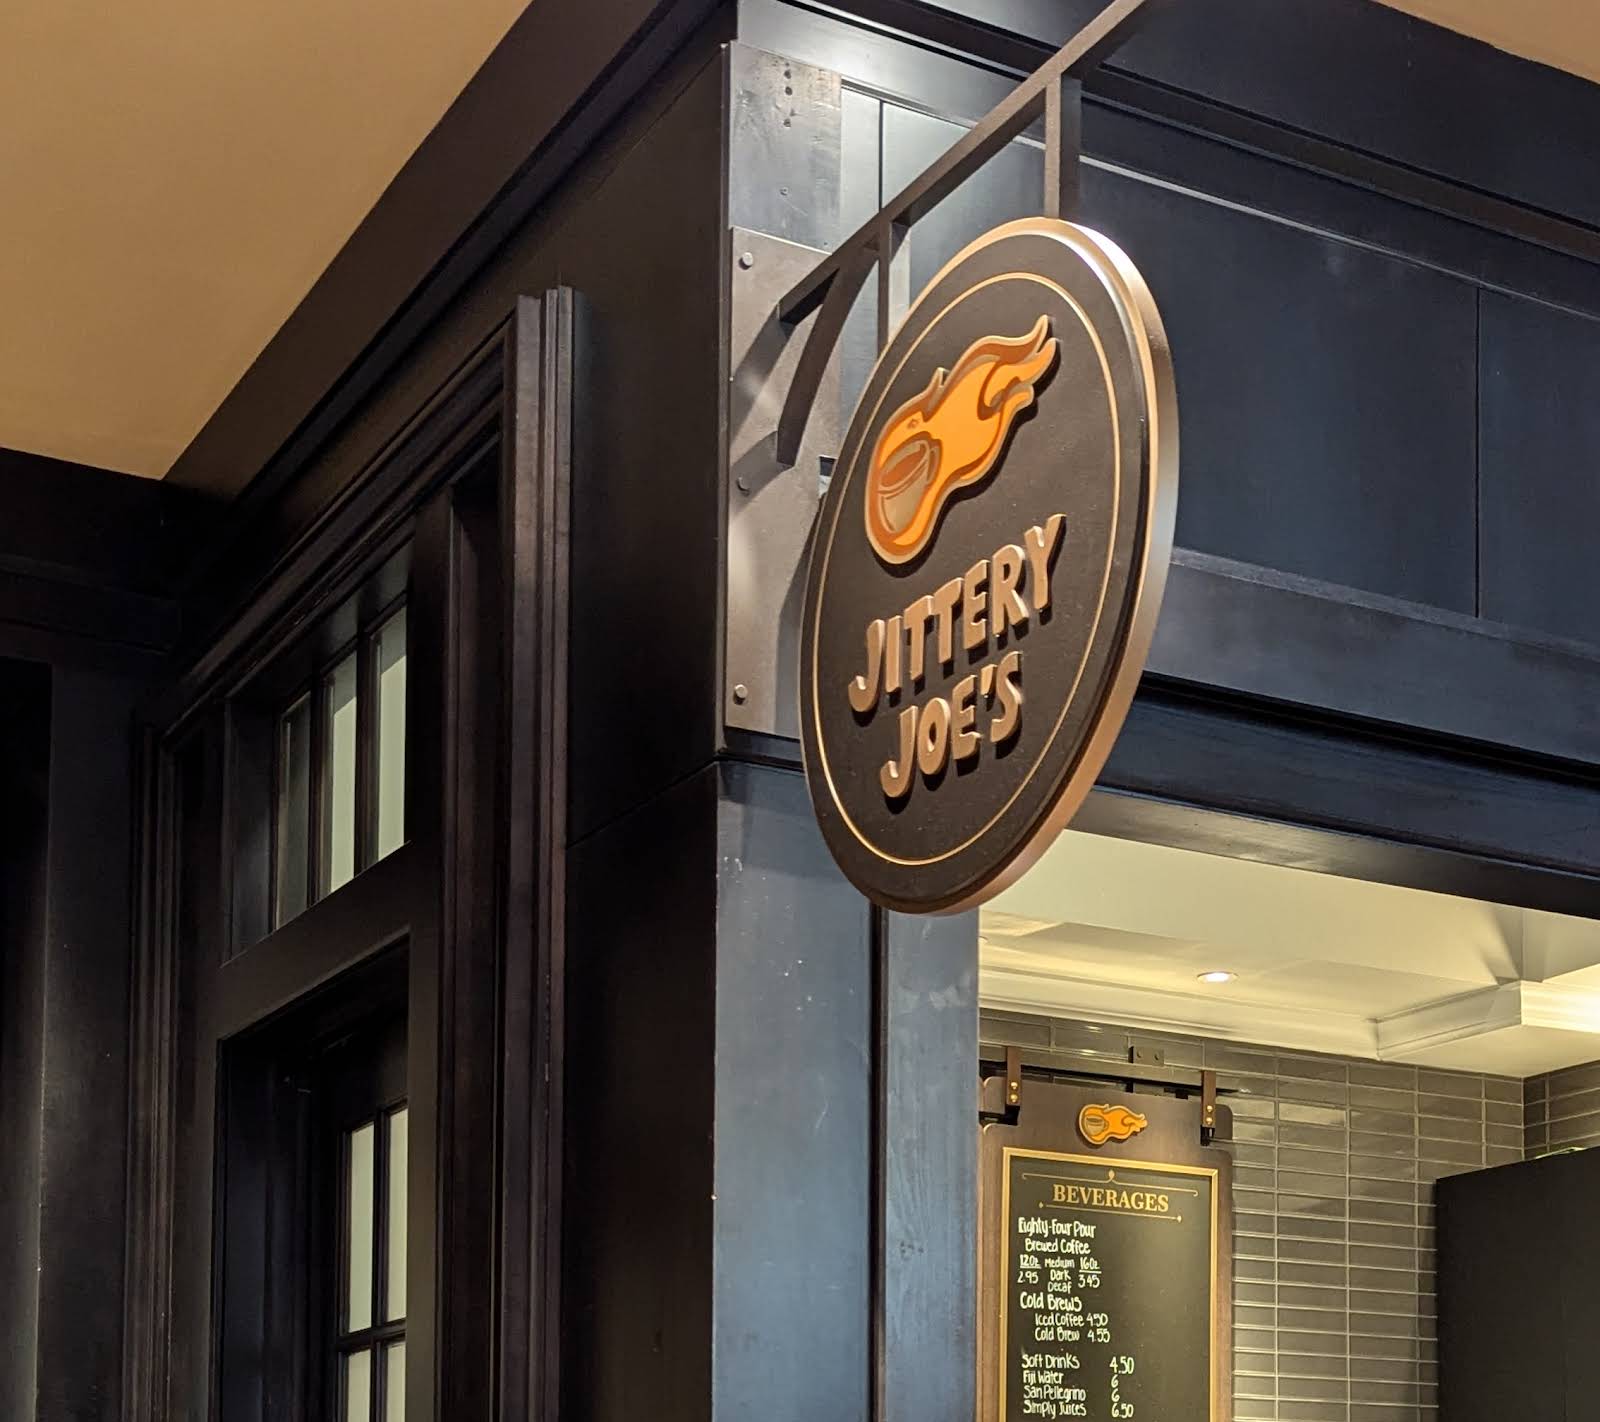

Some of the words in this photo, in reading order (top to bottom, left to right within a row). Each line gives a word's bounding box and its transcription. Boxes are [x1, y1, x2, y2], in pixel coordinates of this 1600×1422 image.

[849, 514, 1066, 712] JITTERY
[880, 651, 1024, 798] JOE'S
[1053, 1184, 1169, 1212] BEVERAGES
[1073, 1220, 1096, 1238] Pour
[1024, 1238, 1058, 1253] Brewed
[1060, 1238, 1091, 1255] Coffee
[1050, 1269, 1071, 1281] Dark
[1047, 1281, 1072, 1294] Decaf
[1020, 1291, 1044, 1310] Cold
[1035, 1312, 1054, 1326] Iced
[1055, 1313, 1084, 1327] Coffee
[1035, 1327, 1054, 1341] Cold
[1057, 1327, 1080, 1341] Brew
[1022, 1354, 1043, 1368] Soft
[1109, 1356, 1134, 1374] 4.50
[1023, 1370, 1037, 1385] Fiji
[1038, 1370, 1064, 1384] Water
[1111, 1374, 1118, 1388] 6
[1023, 1385, 1043, 1399] San
[1044, 1385, 1086, 1403] Pellegrino
[1111, 1388, 1120, 1402] 6
[1059, 1402, 1086, 1416] Juices
[1111, 1403, 1134, 1418] 6.50
